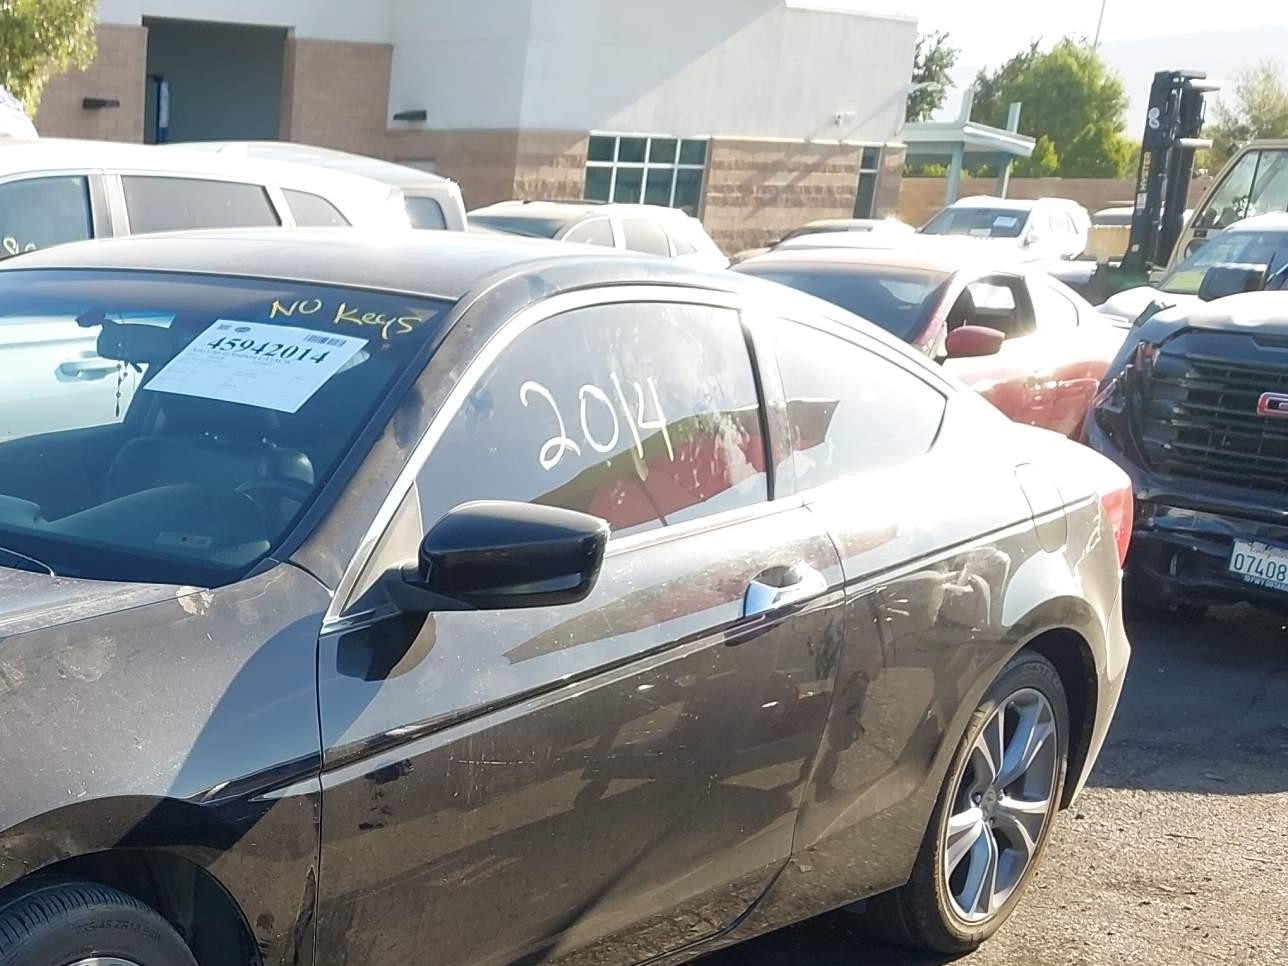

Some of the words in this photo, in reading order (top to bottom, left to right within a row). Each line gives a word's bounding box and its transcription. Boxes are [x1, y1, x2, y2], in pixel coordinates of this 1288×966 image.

[270, 299, 323, 319] NO
[333, 302, 423, 340] Keys
[207, 336, 330, 364] 45942014
[519, 371, 674, 471] 2014
[1234, 553, 1288, 582] 07408
